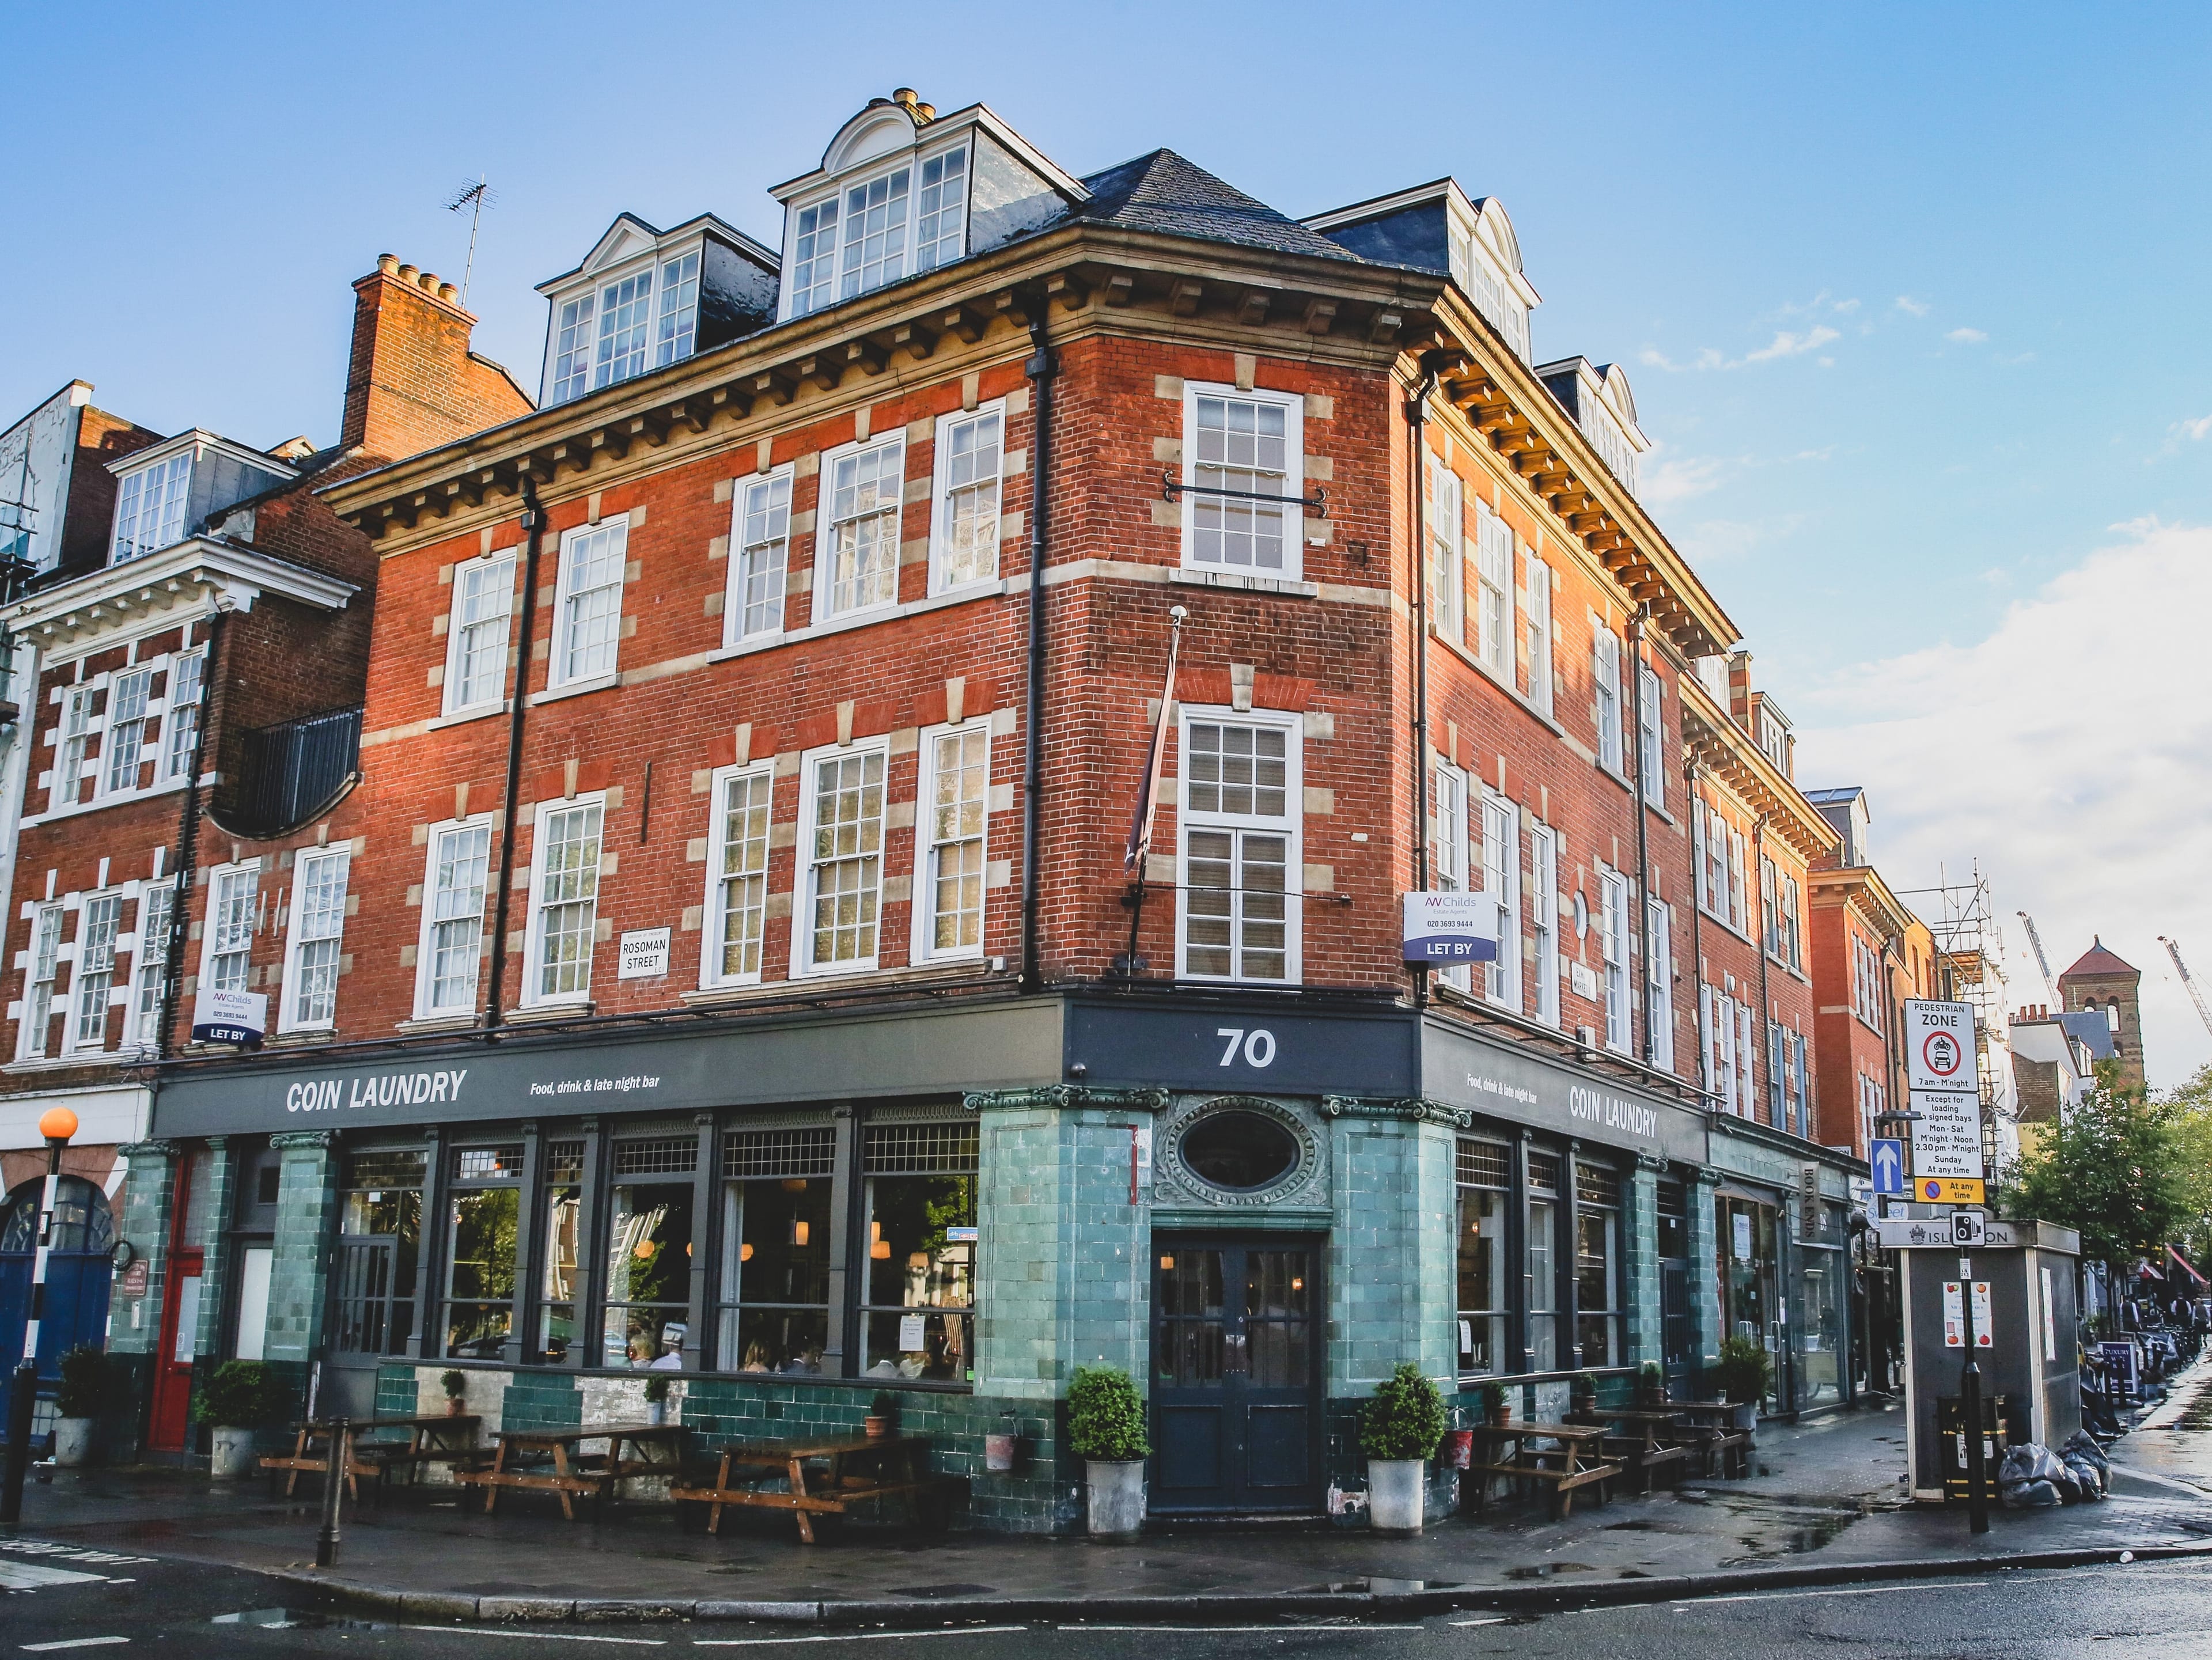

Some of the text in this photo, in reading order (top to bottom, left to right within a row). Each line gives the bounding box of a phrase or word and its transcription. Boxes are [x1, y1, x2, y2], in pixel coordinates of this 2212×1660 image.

[623, 938, 666, 955] ROSOMAN
[1426, 943, 1473, 955] LET BY
[627, 954, 660, 969] STREET
[1914, 1003, 1965, 1013] PEDESTRIAN
[1922, 1014, 1959, 1027] ZONE
[210, 1028, 246, 1041] LET BY
[1217, 1028, 1277, 1068] 70
[286, 1069, 468, 1112] COIN LAUNDRY
[530, 1075, 661, 1096] Food, drink & late night bar
[1467, 1072, 1537, 1104] Food, drink & late night bar
[1926, 1094, 1951, 1104] Except
[1569, 1085, 1657, 1139] COIN LAUNDRY
[1931, 1104, 1959, 1113] loading
[1929, 1113, 1953, 1122] signed
[1955, 1115, 1972, 1123] bays
[1929, 1124, 1945, 1132] Mon
[1951, 1125, 1964, 1133] Sat
[1954, 1135, 1974, 1143] Noon
[1915, 1143, 1934, 1151] 2.30
[1935, 1145, 1946, 1153] pm
[1934, 1155, 1962, 1165] Sunday
[1927, 1165, 1936, 1173] At
[1938, 1167, 1952, 1175] any
[1950, 1182, 1959, 1190] At
[1954, 1191, 1971, 1199] time
[1804, 1168, 1815, 1238] BOOK ENDS
